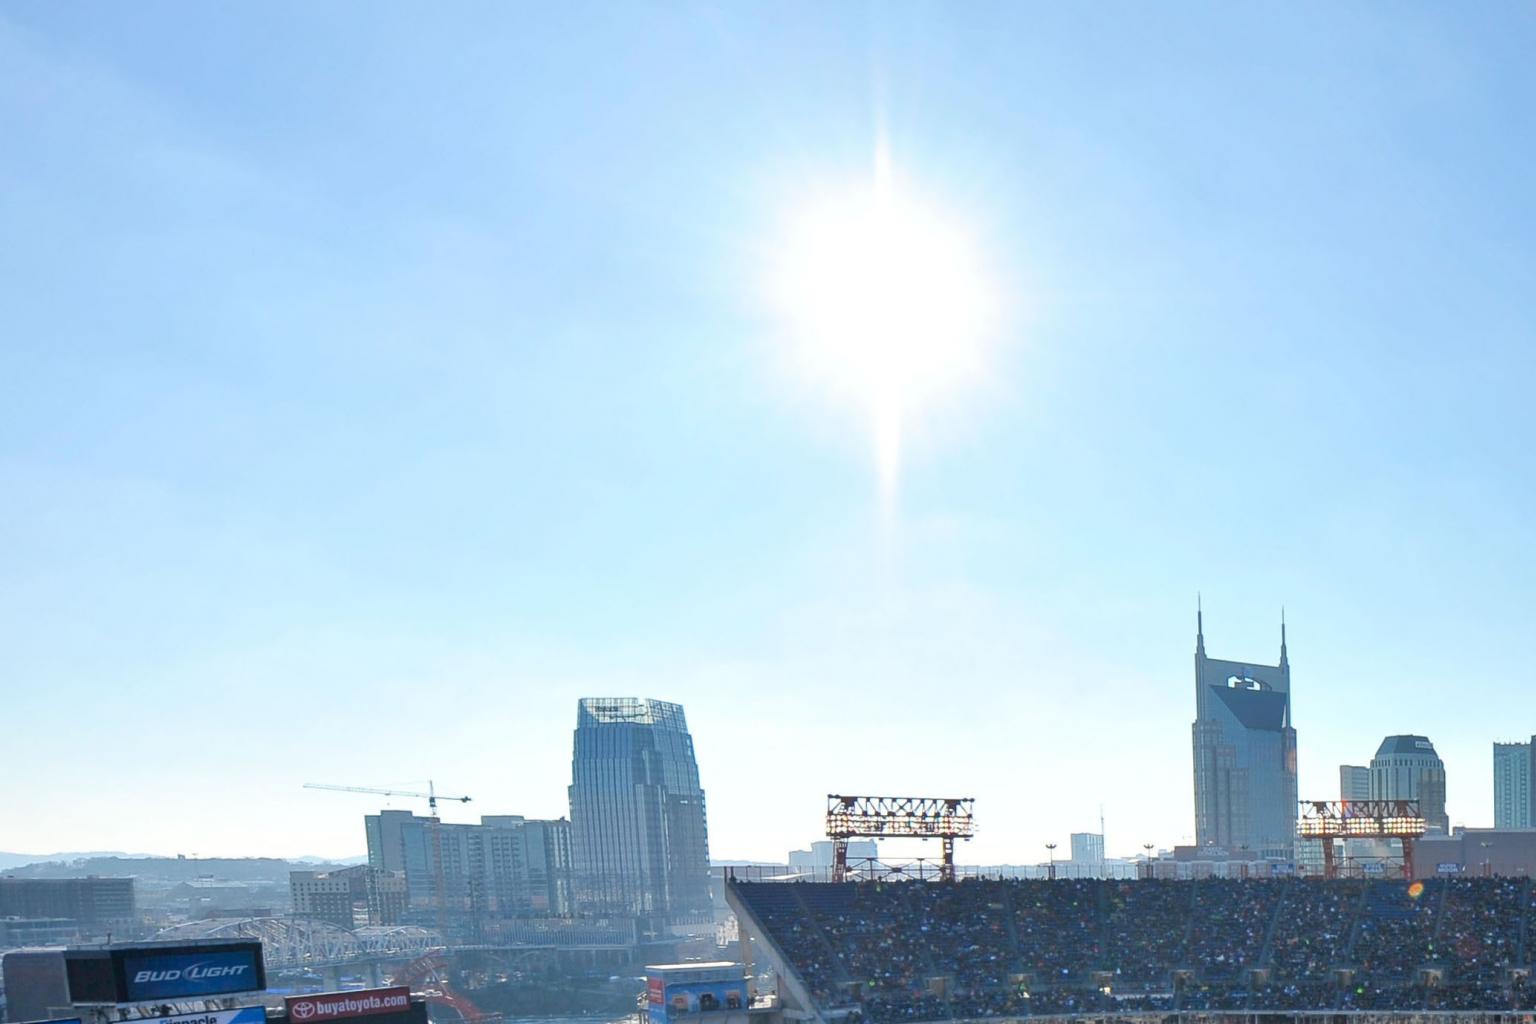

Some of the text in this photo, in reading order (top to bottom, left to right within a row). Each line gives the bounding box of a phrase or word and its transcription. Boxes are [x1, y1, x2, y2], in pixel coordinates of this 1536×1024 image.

[133, 964, 249, 984] BUD LIGHT
[316, 994, 407, 1015] buyatoyota.com
